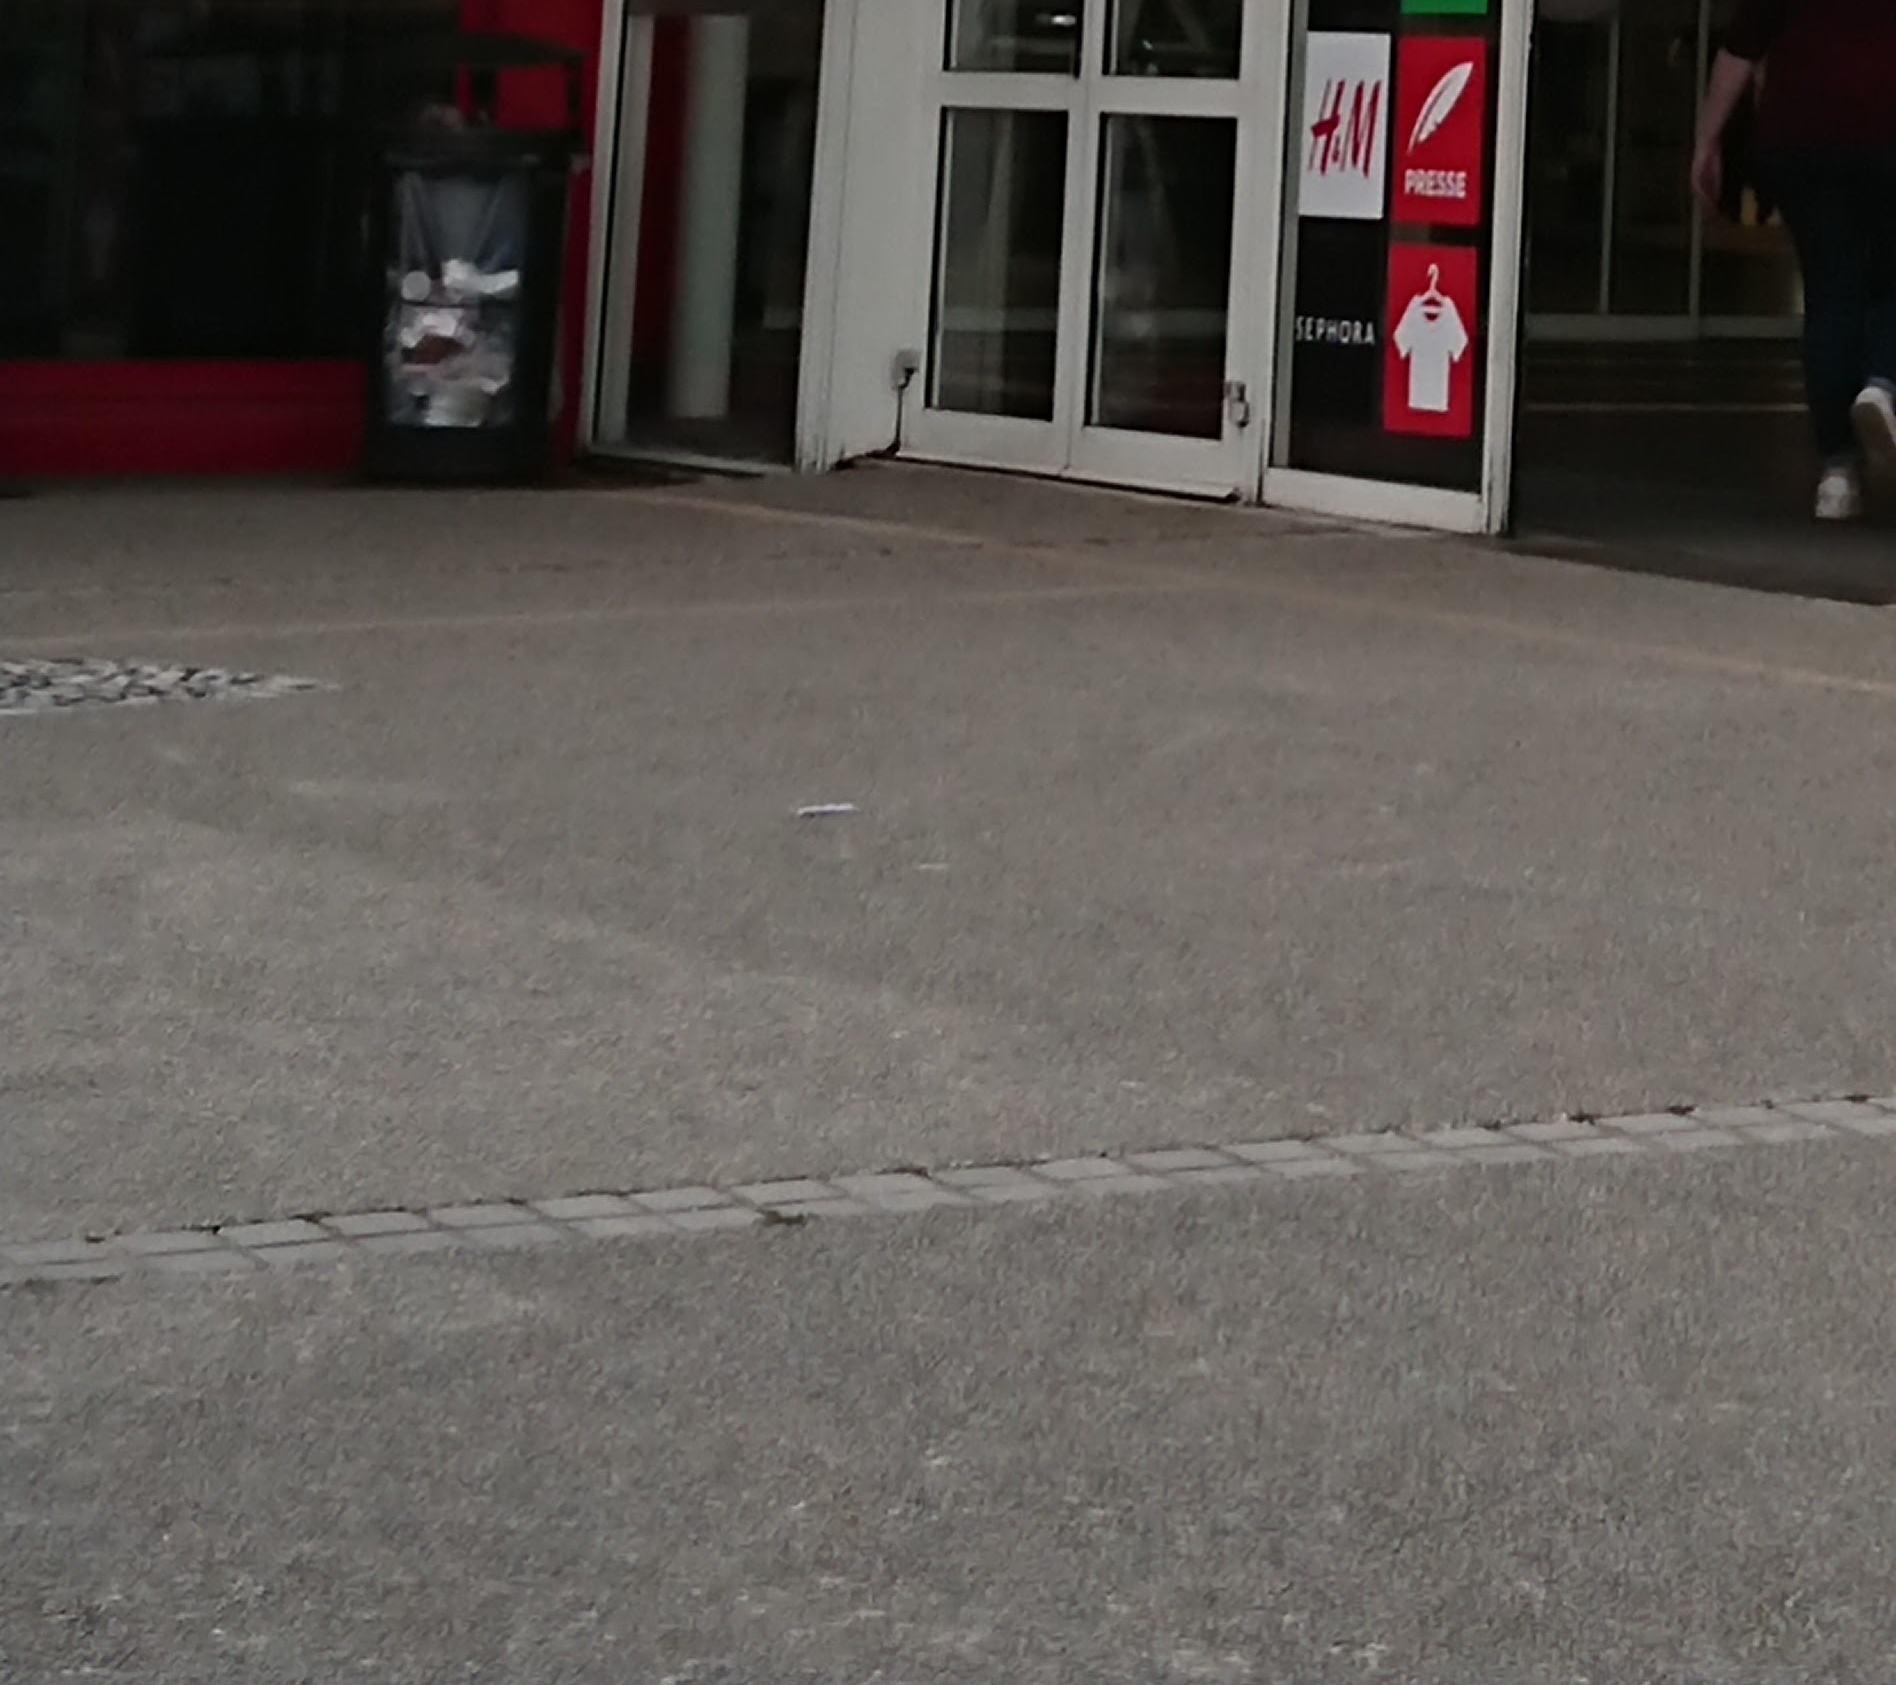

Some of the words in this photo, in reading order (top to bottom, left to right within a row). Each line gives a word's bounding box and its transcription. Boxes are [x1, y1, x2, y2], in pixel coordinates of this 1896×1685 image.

[1308, 78, 1382, 178] H&M
[1404, 168, 1468, 199] PRESSE
[1296, 315, 1376, 345] SEPHORA
